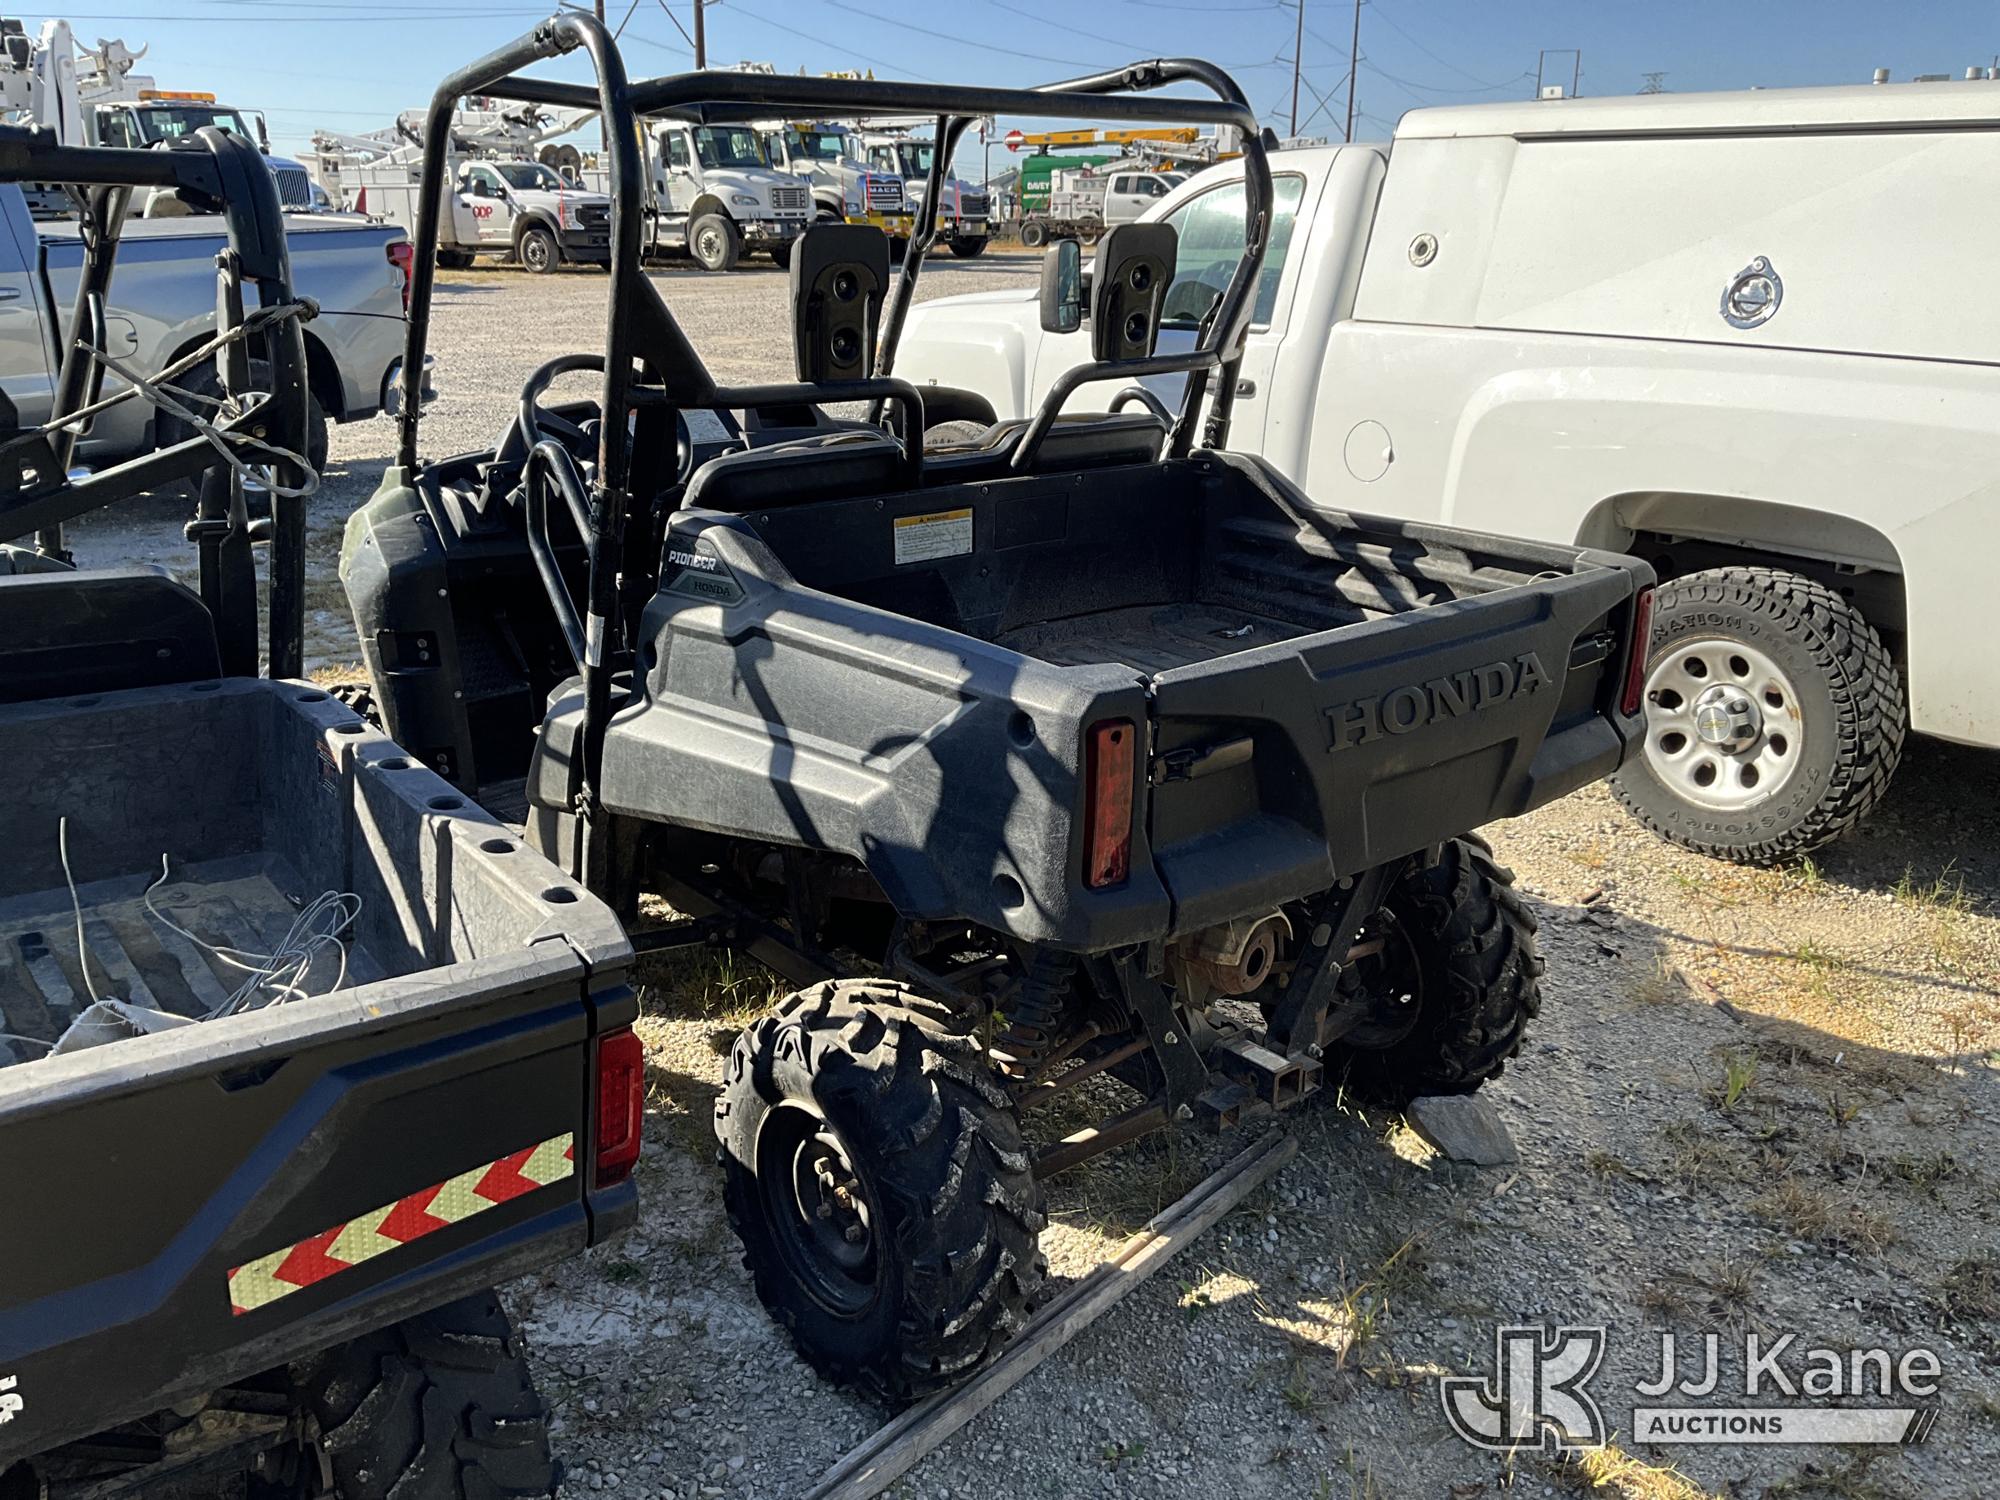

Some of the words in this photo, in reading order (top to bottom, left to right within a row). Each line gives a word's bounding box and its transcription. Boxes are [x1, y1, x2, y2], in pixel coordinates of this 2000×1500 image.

[668, 550, 716, 570] PIONEER
[694, 582, 730, 596] HONDA
[1325, 651, 1552, 752] HONDA
